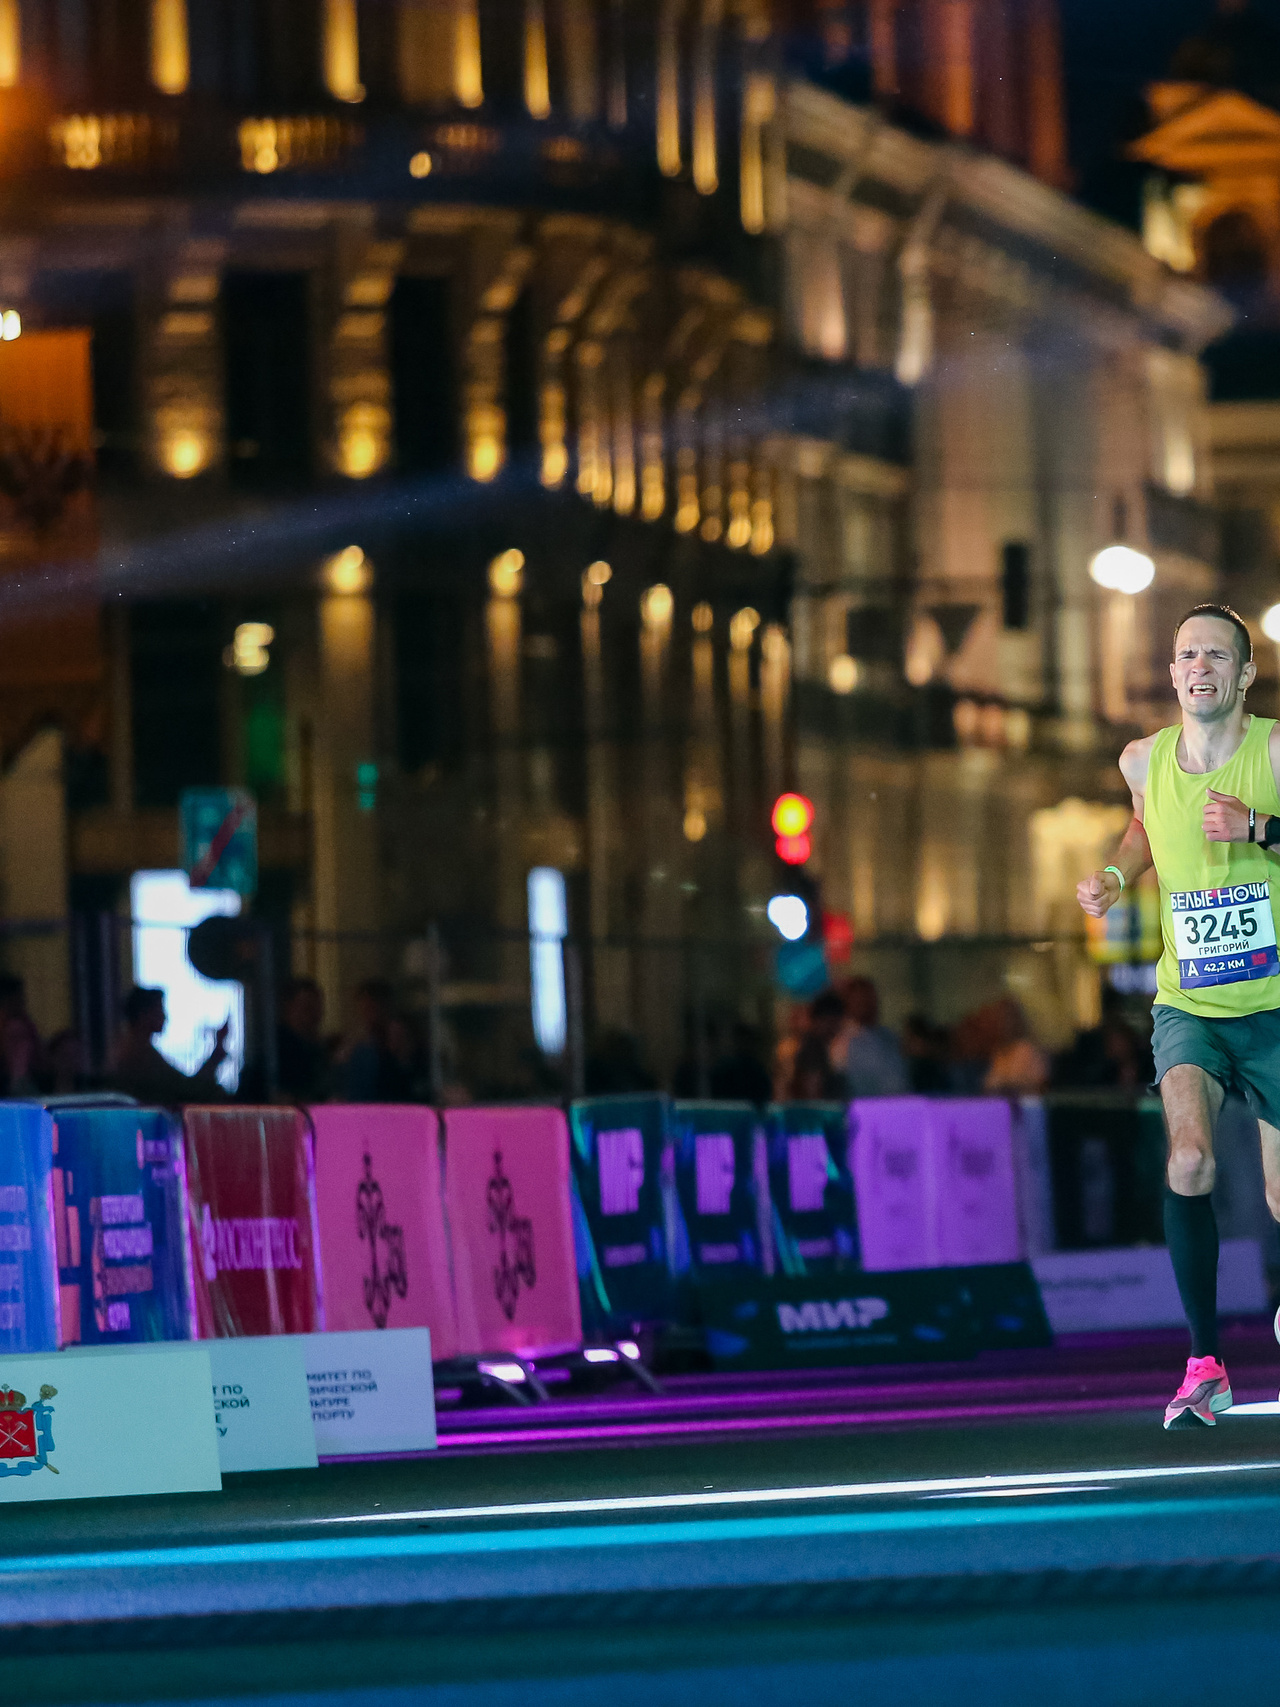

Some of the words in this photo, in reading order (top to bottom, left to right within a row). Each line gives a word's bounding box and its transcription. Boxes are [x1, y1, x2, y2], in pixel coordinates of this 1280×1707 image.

[1170, 890, 1214, 910] БЕЛЫЕ
[1216, 881, 1270, 905] НОЧИ
[1184, 907, 1258, 944] 3245
[1198, 939, 1250, 956] ГРИГОРИЙ
[1187, 960, 1199, 977] A
[1203, 962, 1226, 973] 42,2
[1227, 959, 1245, 970] КМ
[776, 1297, 888, 1333] МИР
[351, 1369, 372, 1381] ПО
[222, 1384, 243, 1395] ПО
